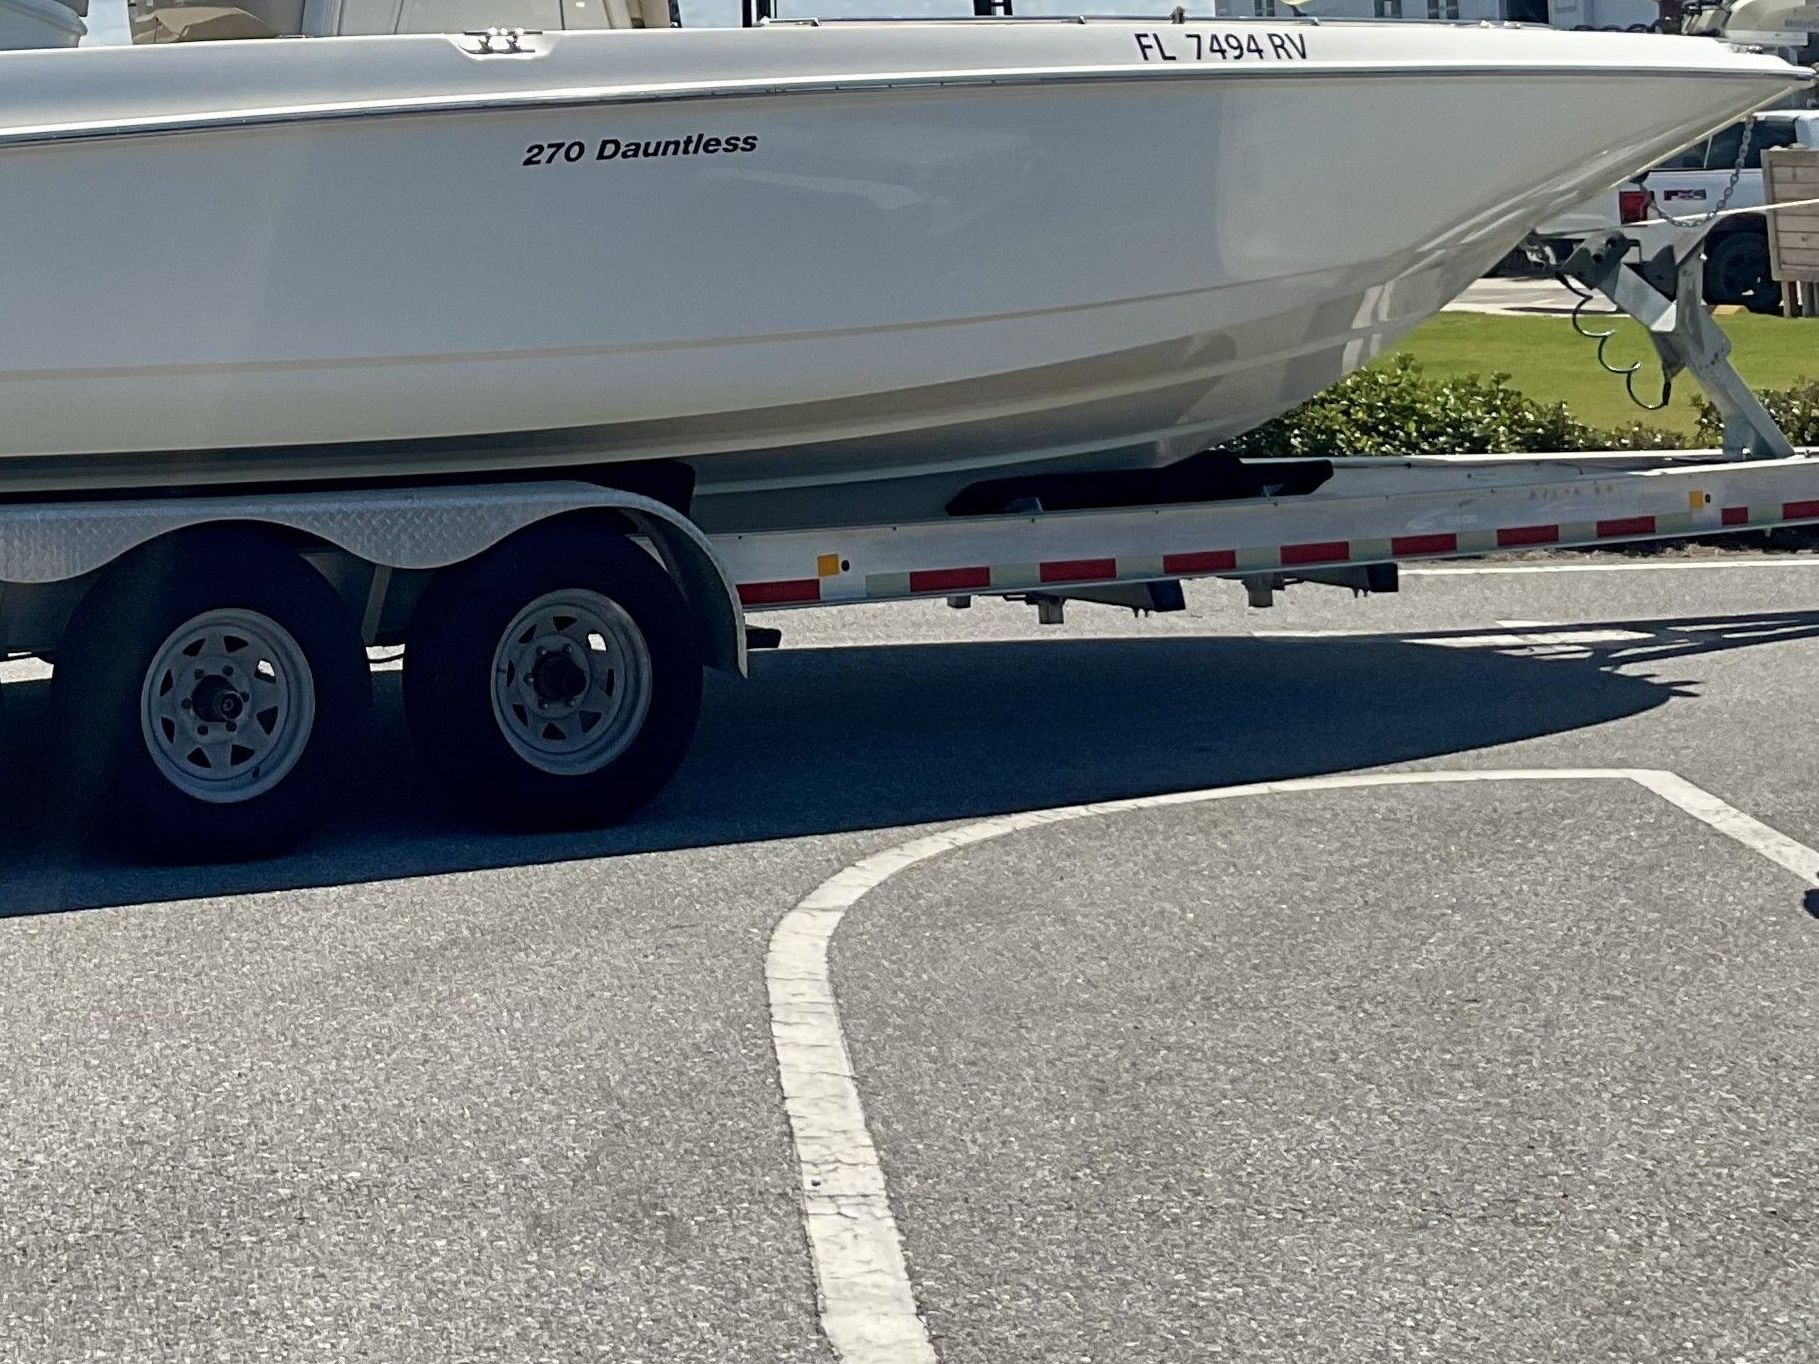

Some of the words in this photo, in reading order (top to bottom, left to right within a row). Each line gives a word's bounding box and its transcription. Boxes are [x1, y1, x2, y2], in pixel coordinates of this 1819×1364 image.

[1134, 33, 1177, 61] FL
[1185, 33, 1264, 60] 7494
[1266, 33, 1307, 60] RV
[522, 140, 585, 167] 270
[596, 133, 758, 161] Dauntless
